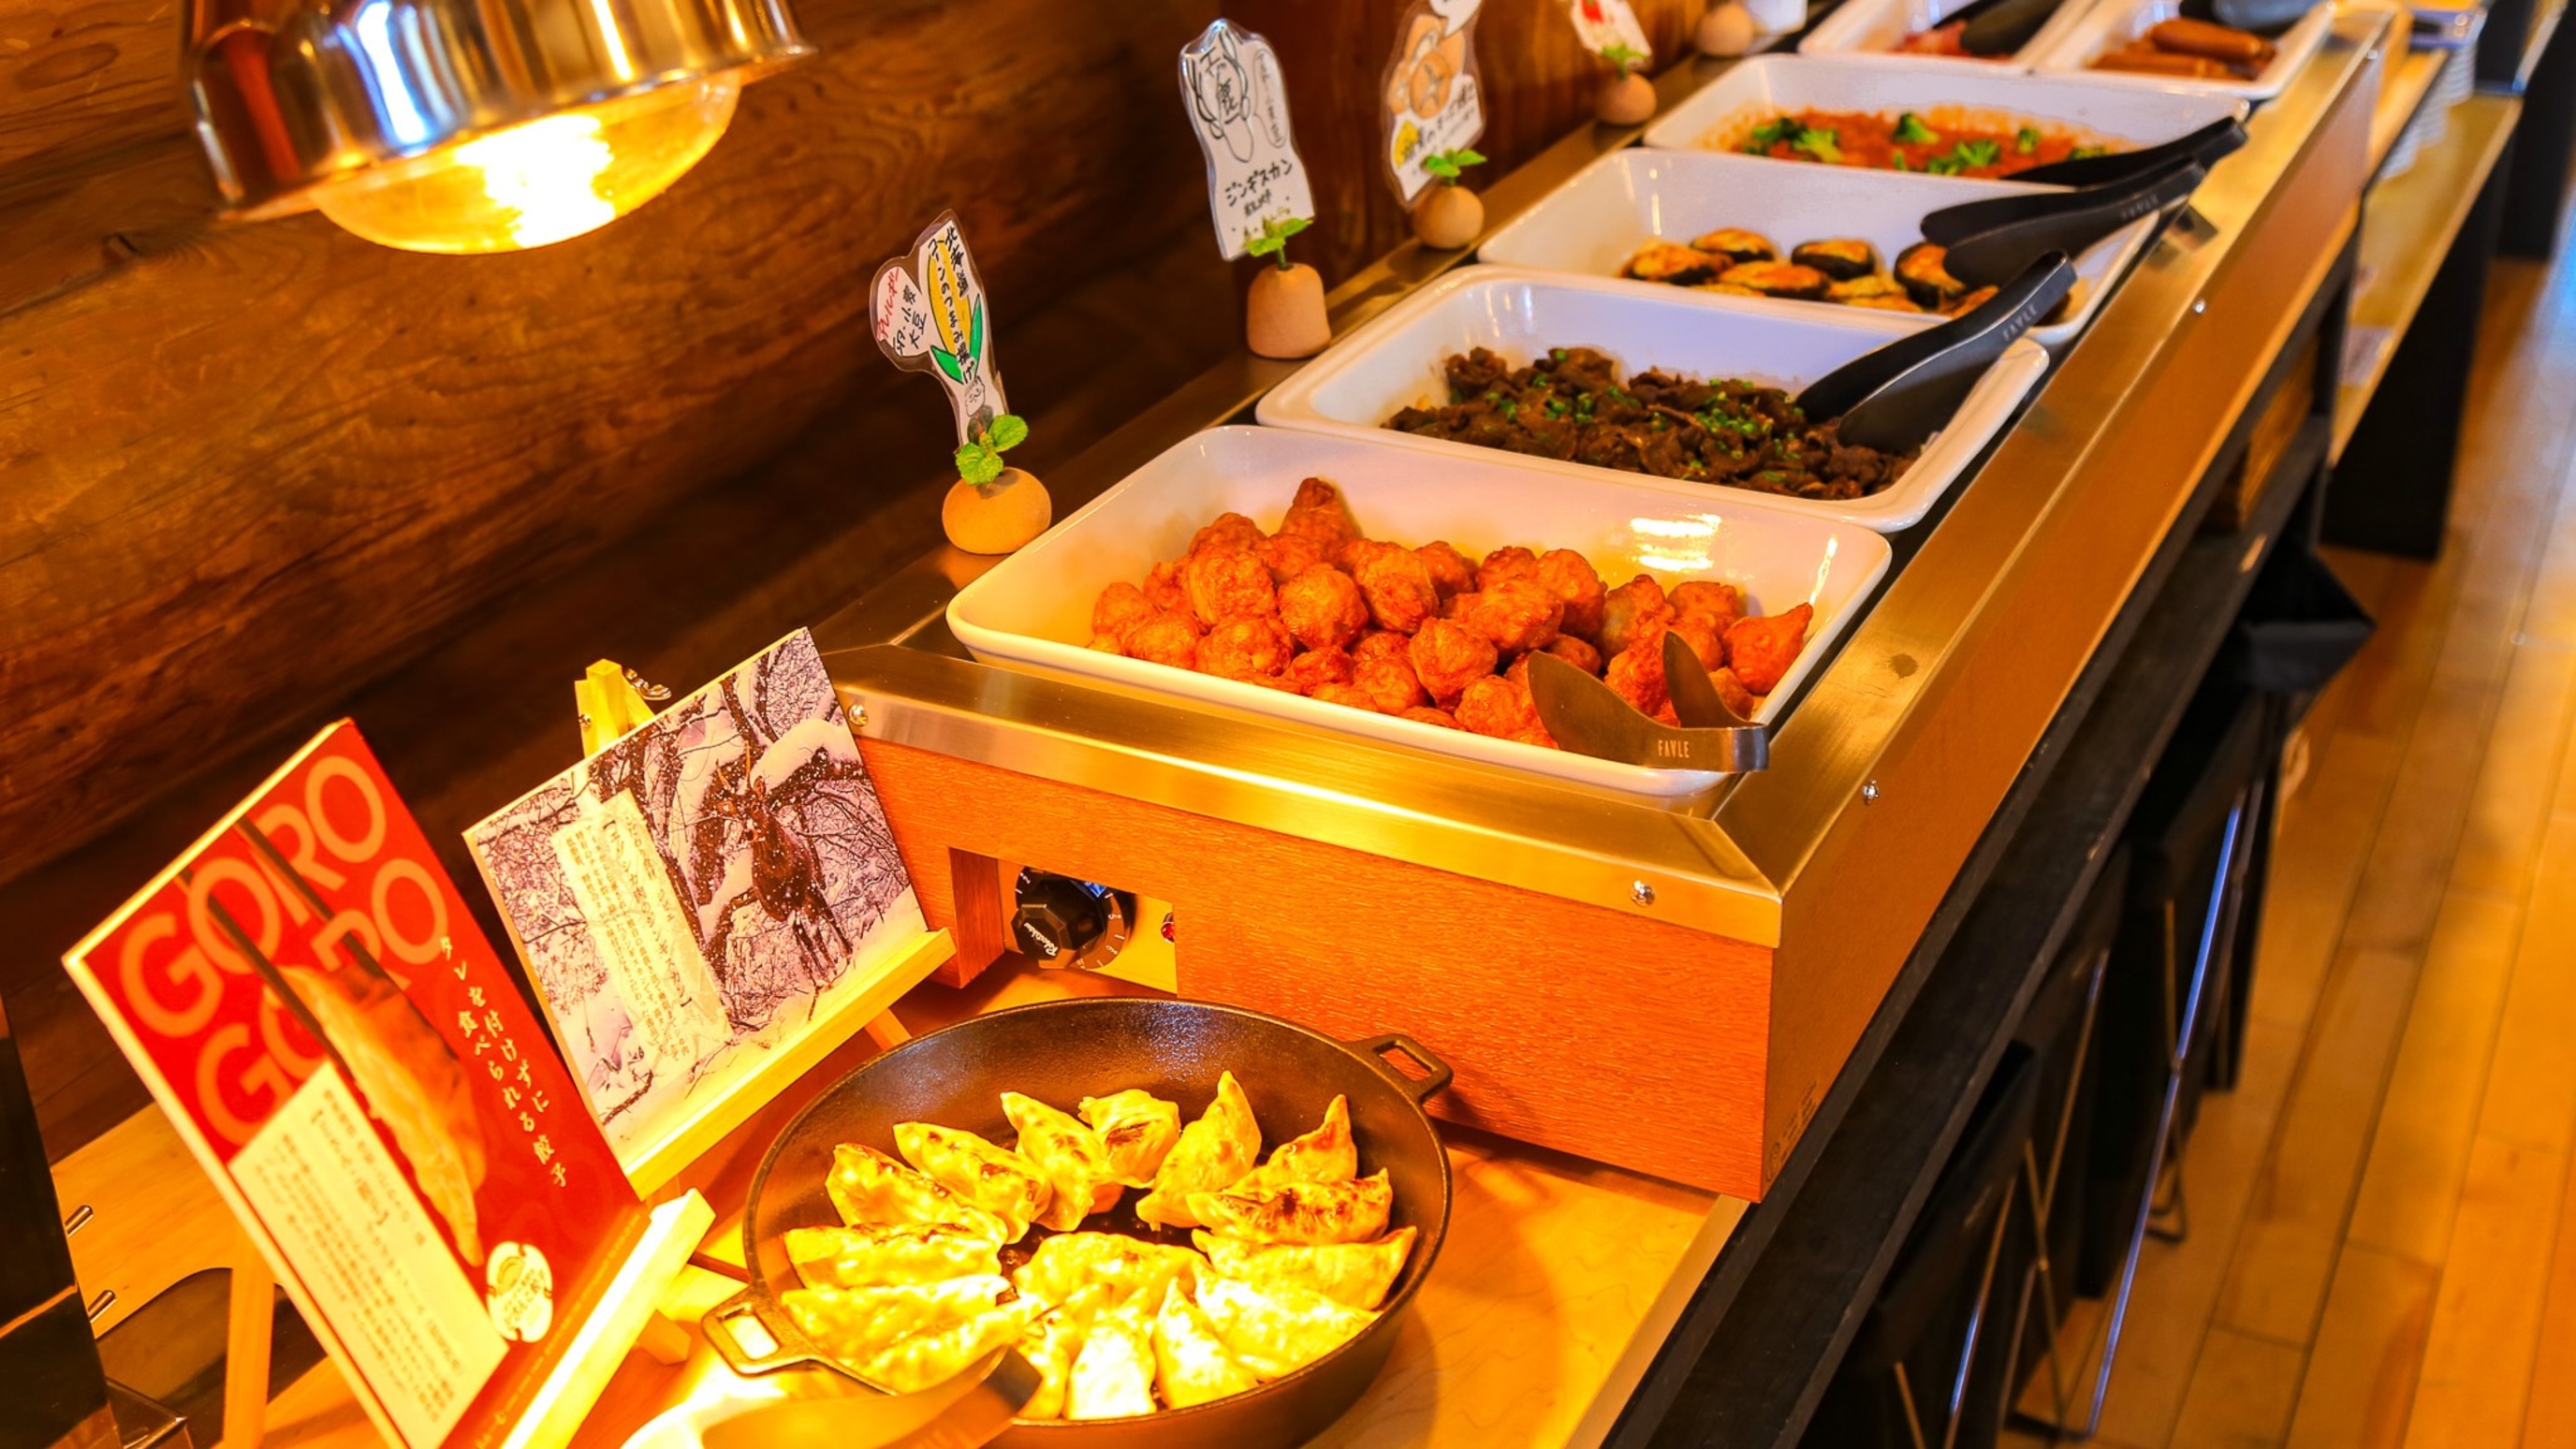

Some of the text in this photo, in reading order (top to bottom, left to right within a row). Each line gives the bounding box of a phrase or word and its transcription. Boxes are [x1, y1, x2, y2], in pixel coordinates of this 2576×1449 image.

[1225, 159, 1293, 207] ジンギスカン
[1658, 739, 1690, 758] FAVLE
[120, 755, 386, 1038] GORO
[440, 936, 549, 1113] タレを付けずに
[459, 1010, 566, 1188] 食べられる餃子
